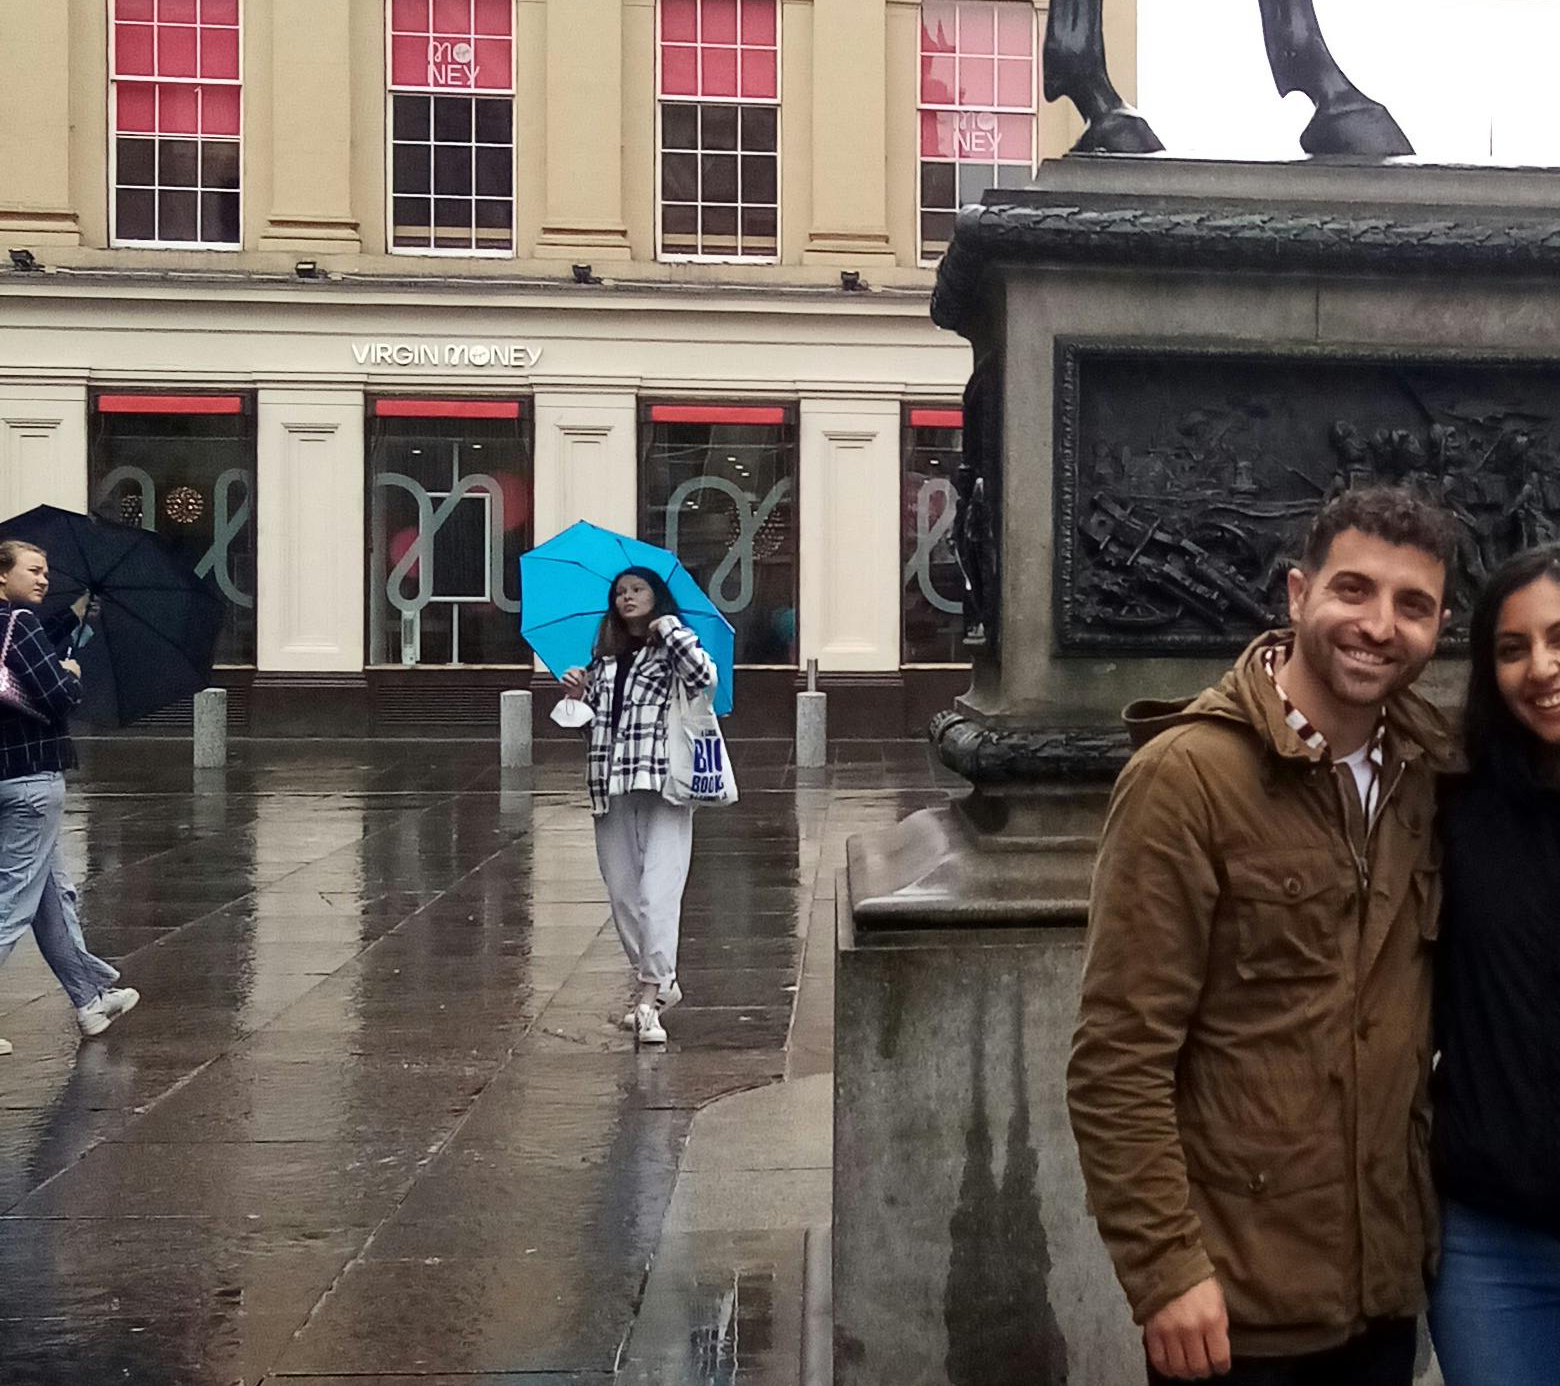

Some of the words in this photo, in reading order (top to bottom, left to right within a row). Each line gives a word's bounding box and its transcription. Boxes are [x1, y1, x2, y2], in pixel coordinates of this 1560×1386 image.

[428, 64, 480, 86] NEY
[351, 343, 440, 366] VIRGIN
[444, 344, 544, 368] MONEY
